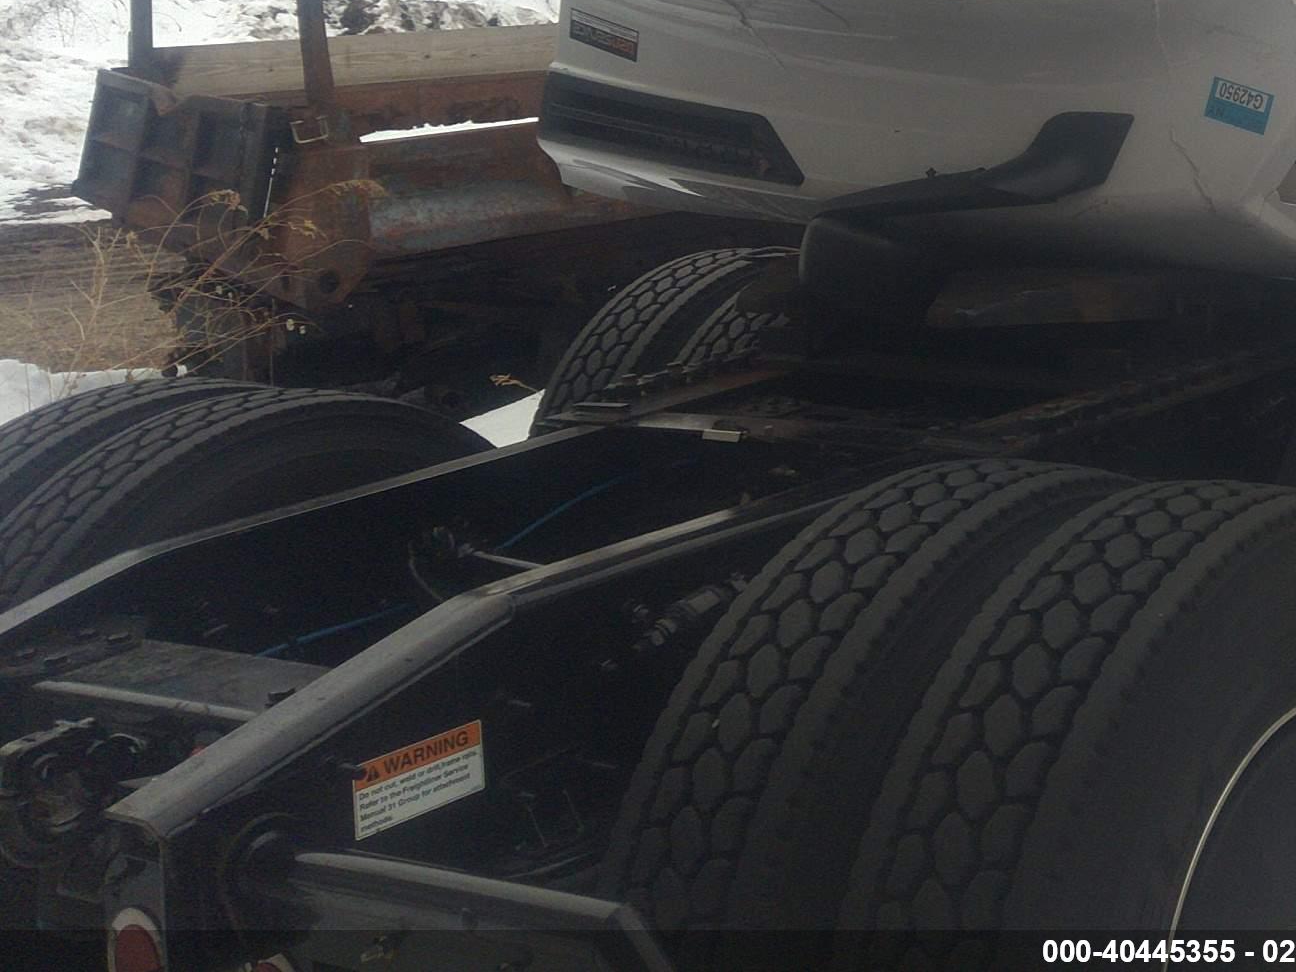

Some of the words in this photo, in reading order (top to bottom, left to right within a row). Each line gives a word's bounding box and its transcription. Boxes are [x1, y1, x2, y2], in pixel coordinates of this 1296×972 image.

[1219, 82, 1264, 110] G42950
[383, 731, 468, 774] WARNING
[360, 799, 380, 810] Refer
[390, 790, 401, 799] the
[444, 764, 468, 778] Service
[371, 787, 383, 796] not
[360, 808, 386, 821] Manual
[422, 789, 432, 797] for
